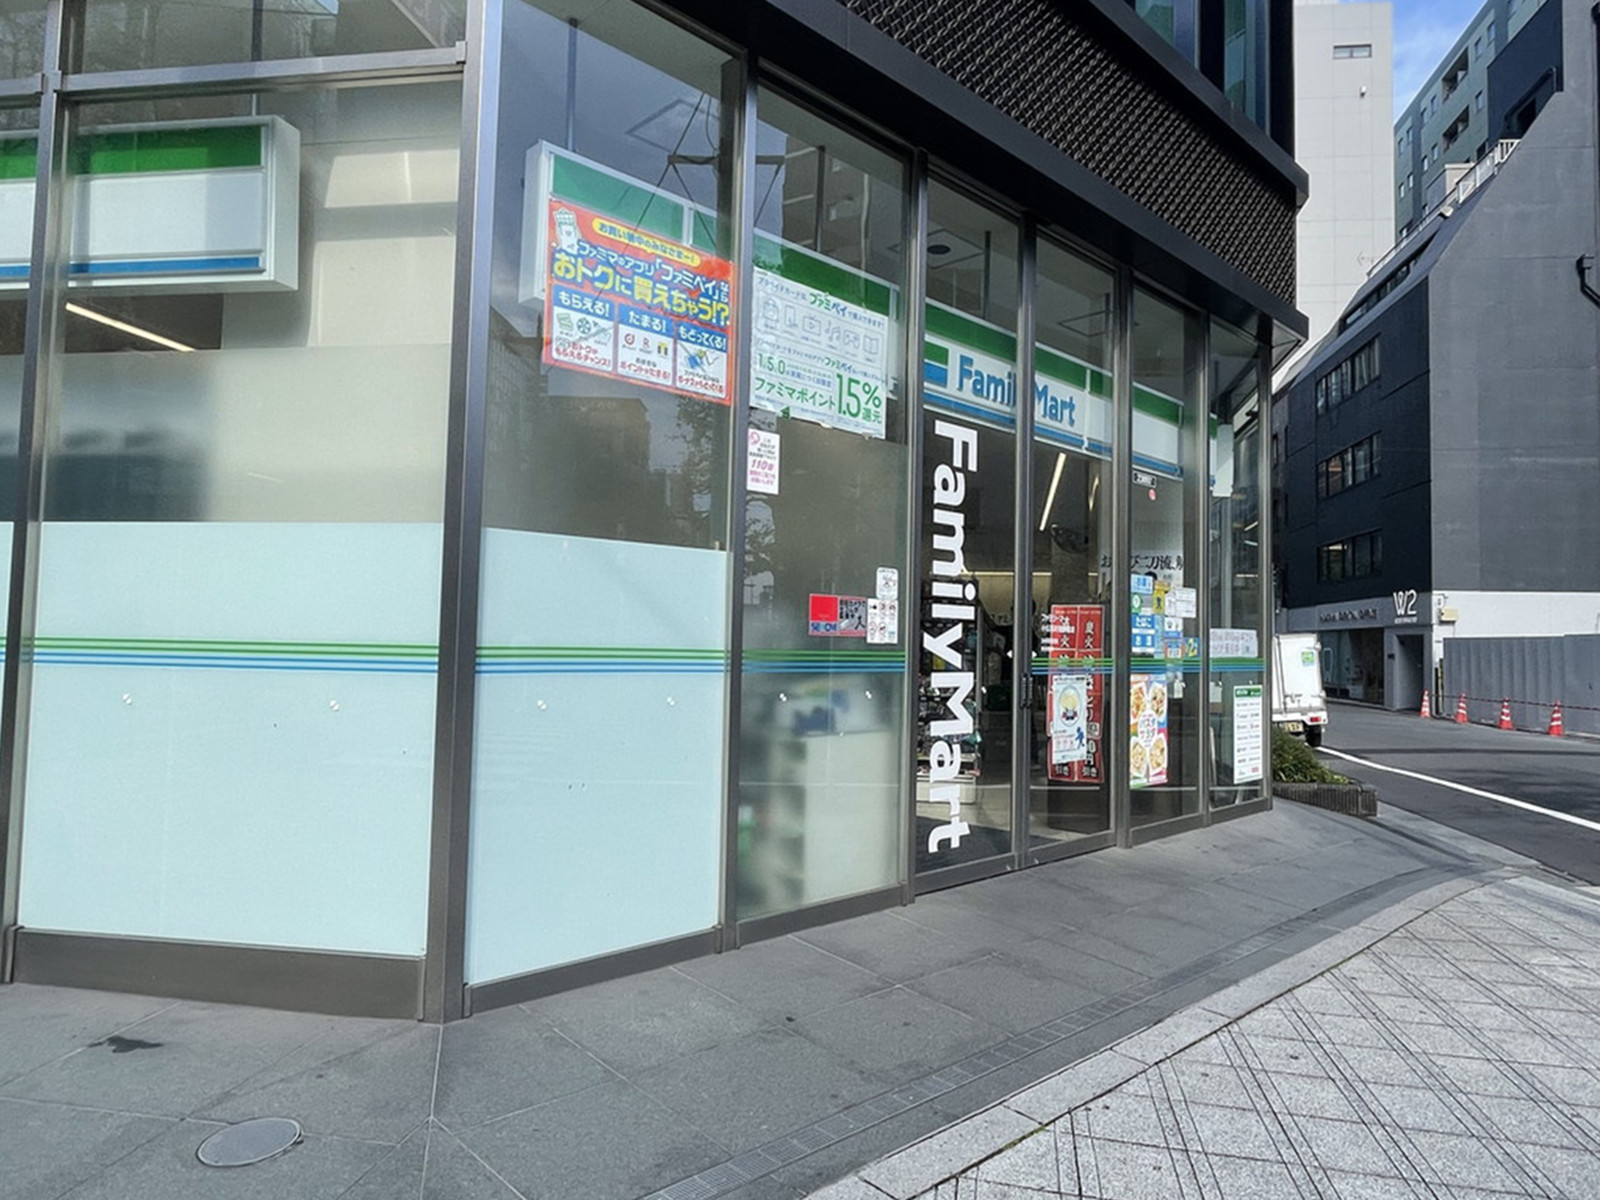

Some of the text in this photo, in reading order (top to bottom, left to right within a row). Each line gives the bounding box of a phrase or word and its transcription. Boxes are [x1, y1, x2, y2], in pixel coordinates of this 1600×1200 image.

[755, 376, 836, 411] ファミマポイント
[923, 419, 979, 853] FamilyMart
